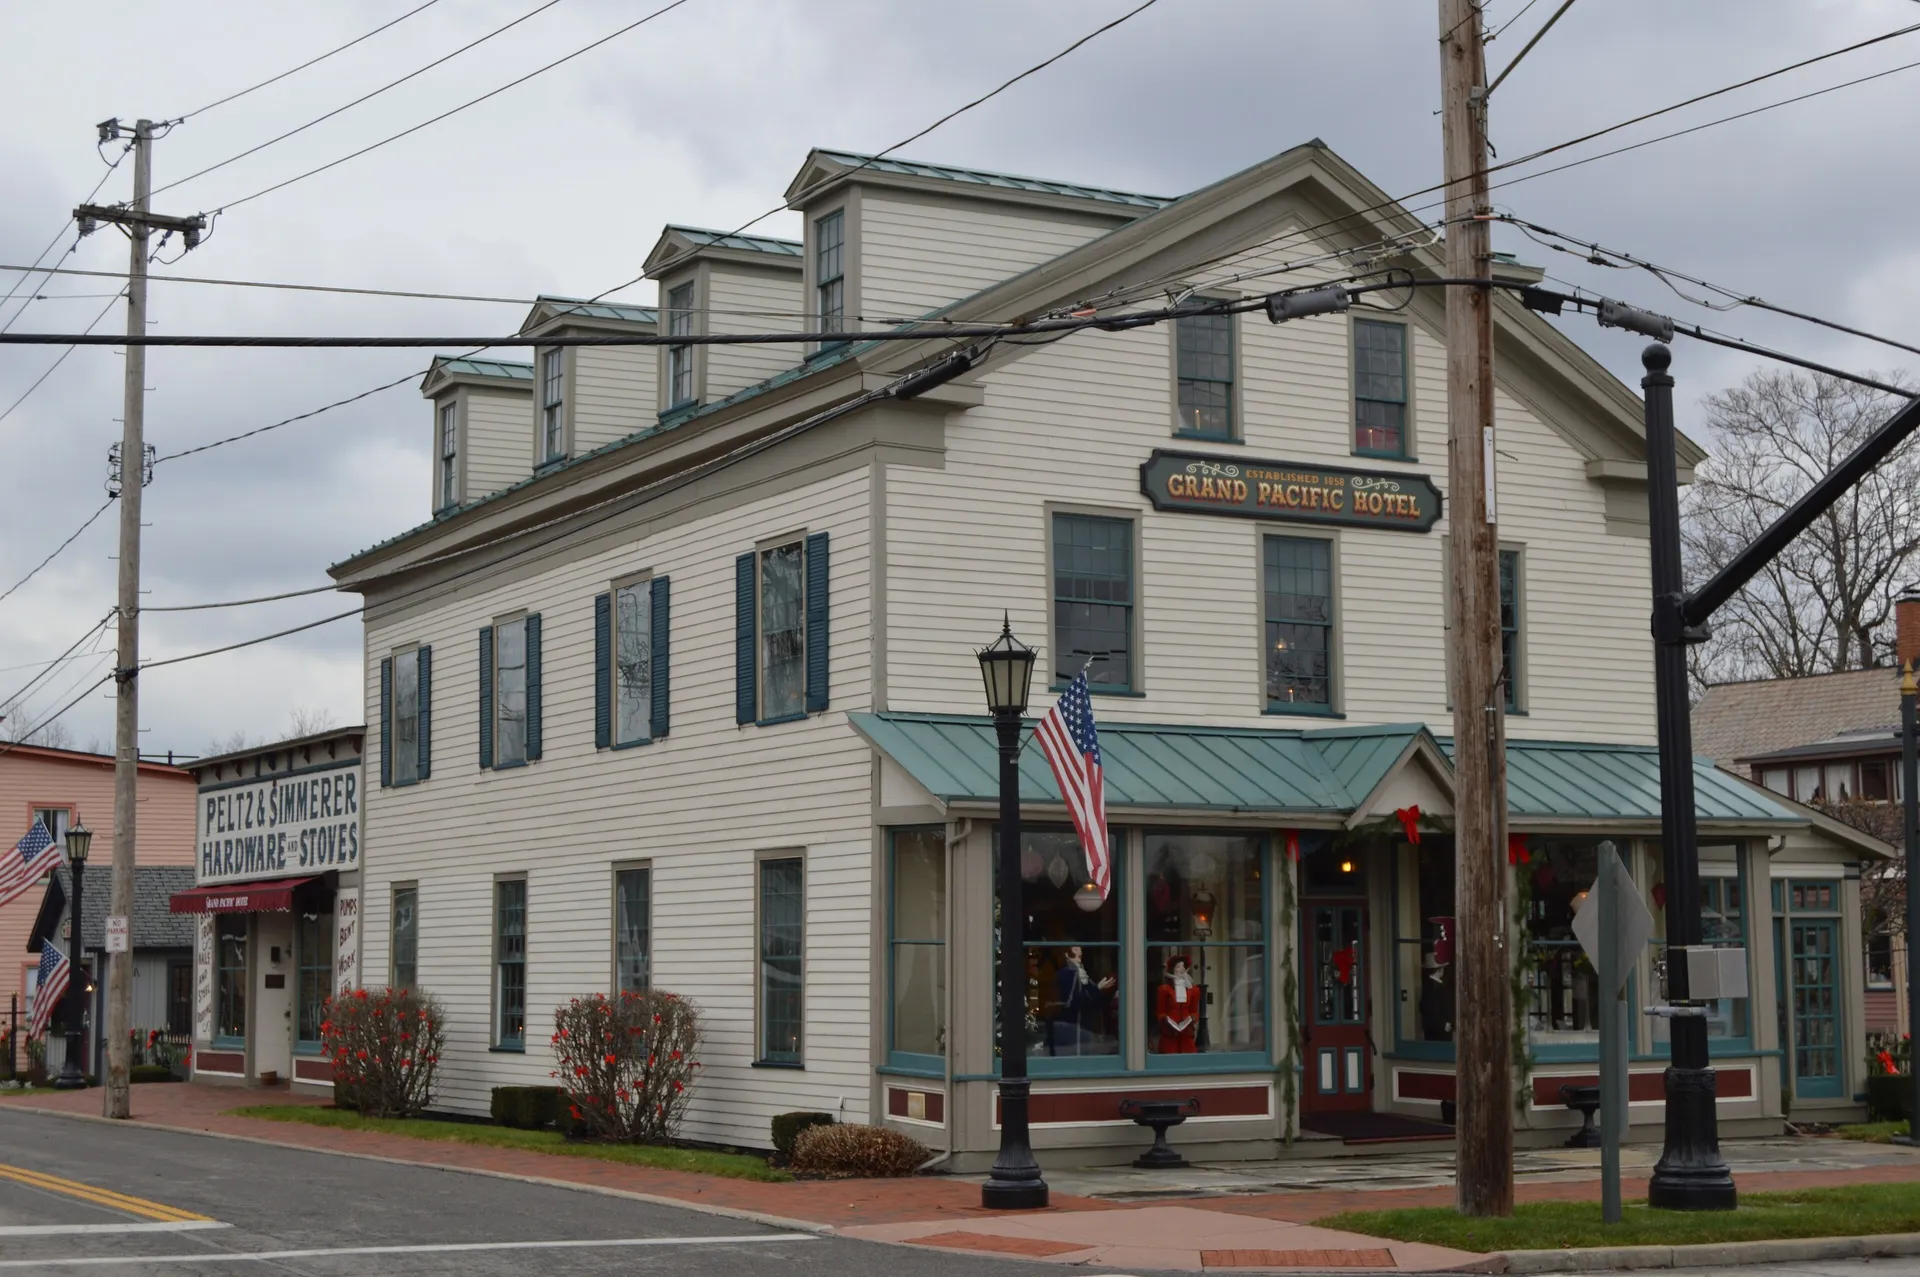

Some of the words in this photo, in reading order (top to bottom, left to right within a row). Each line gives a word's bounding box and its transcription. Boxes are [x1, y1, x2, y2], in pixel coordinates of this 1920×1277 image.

[1246, 469, 1319, 484] ESTABLISHED
[1324, 476, 1345, 486] 1858
[1167, 474, 1249, 505] GRAND
[1257, 482, 1345, 514] PACIFIC
[1353, 490, 1421, 521] HOTEL
[206, 791, 253, 836] PELTZ
[256, 788, 265, 828] &
[269, 772, 358, 828] SIMMERER
[202, 832, 287, 877] HARDWARE
[287, 840, 298, 853] AND
[299, 821, 358, 868] STOVES
[340, 898, 357, 916] PUMPS
[112, 919, 122, 927] NO
[339, 920, 356, 948] BENT
